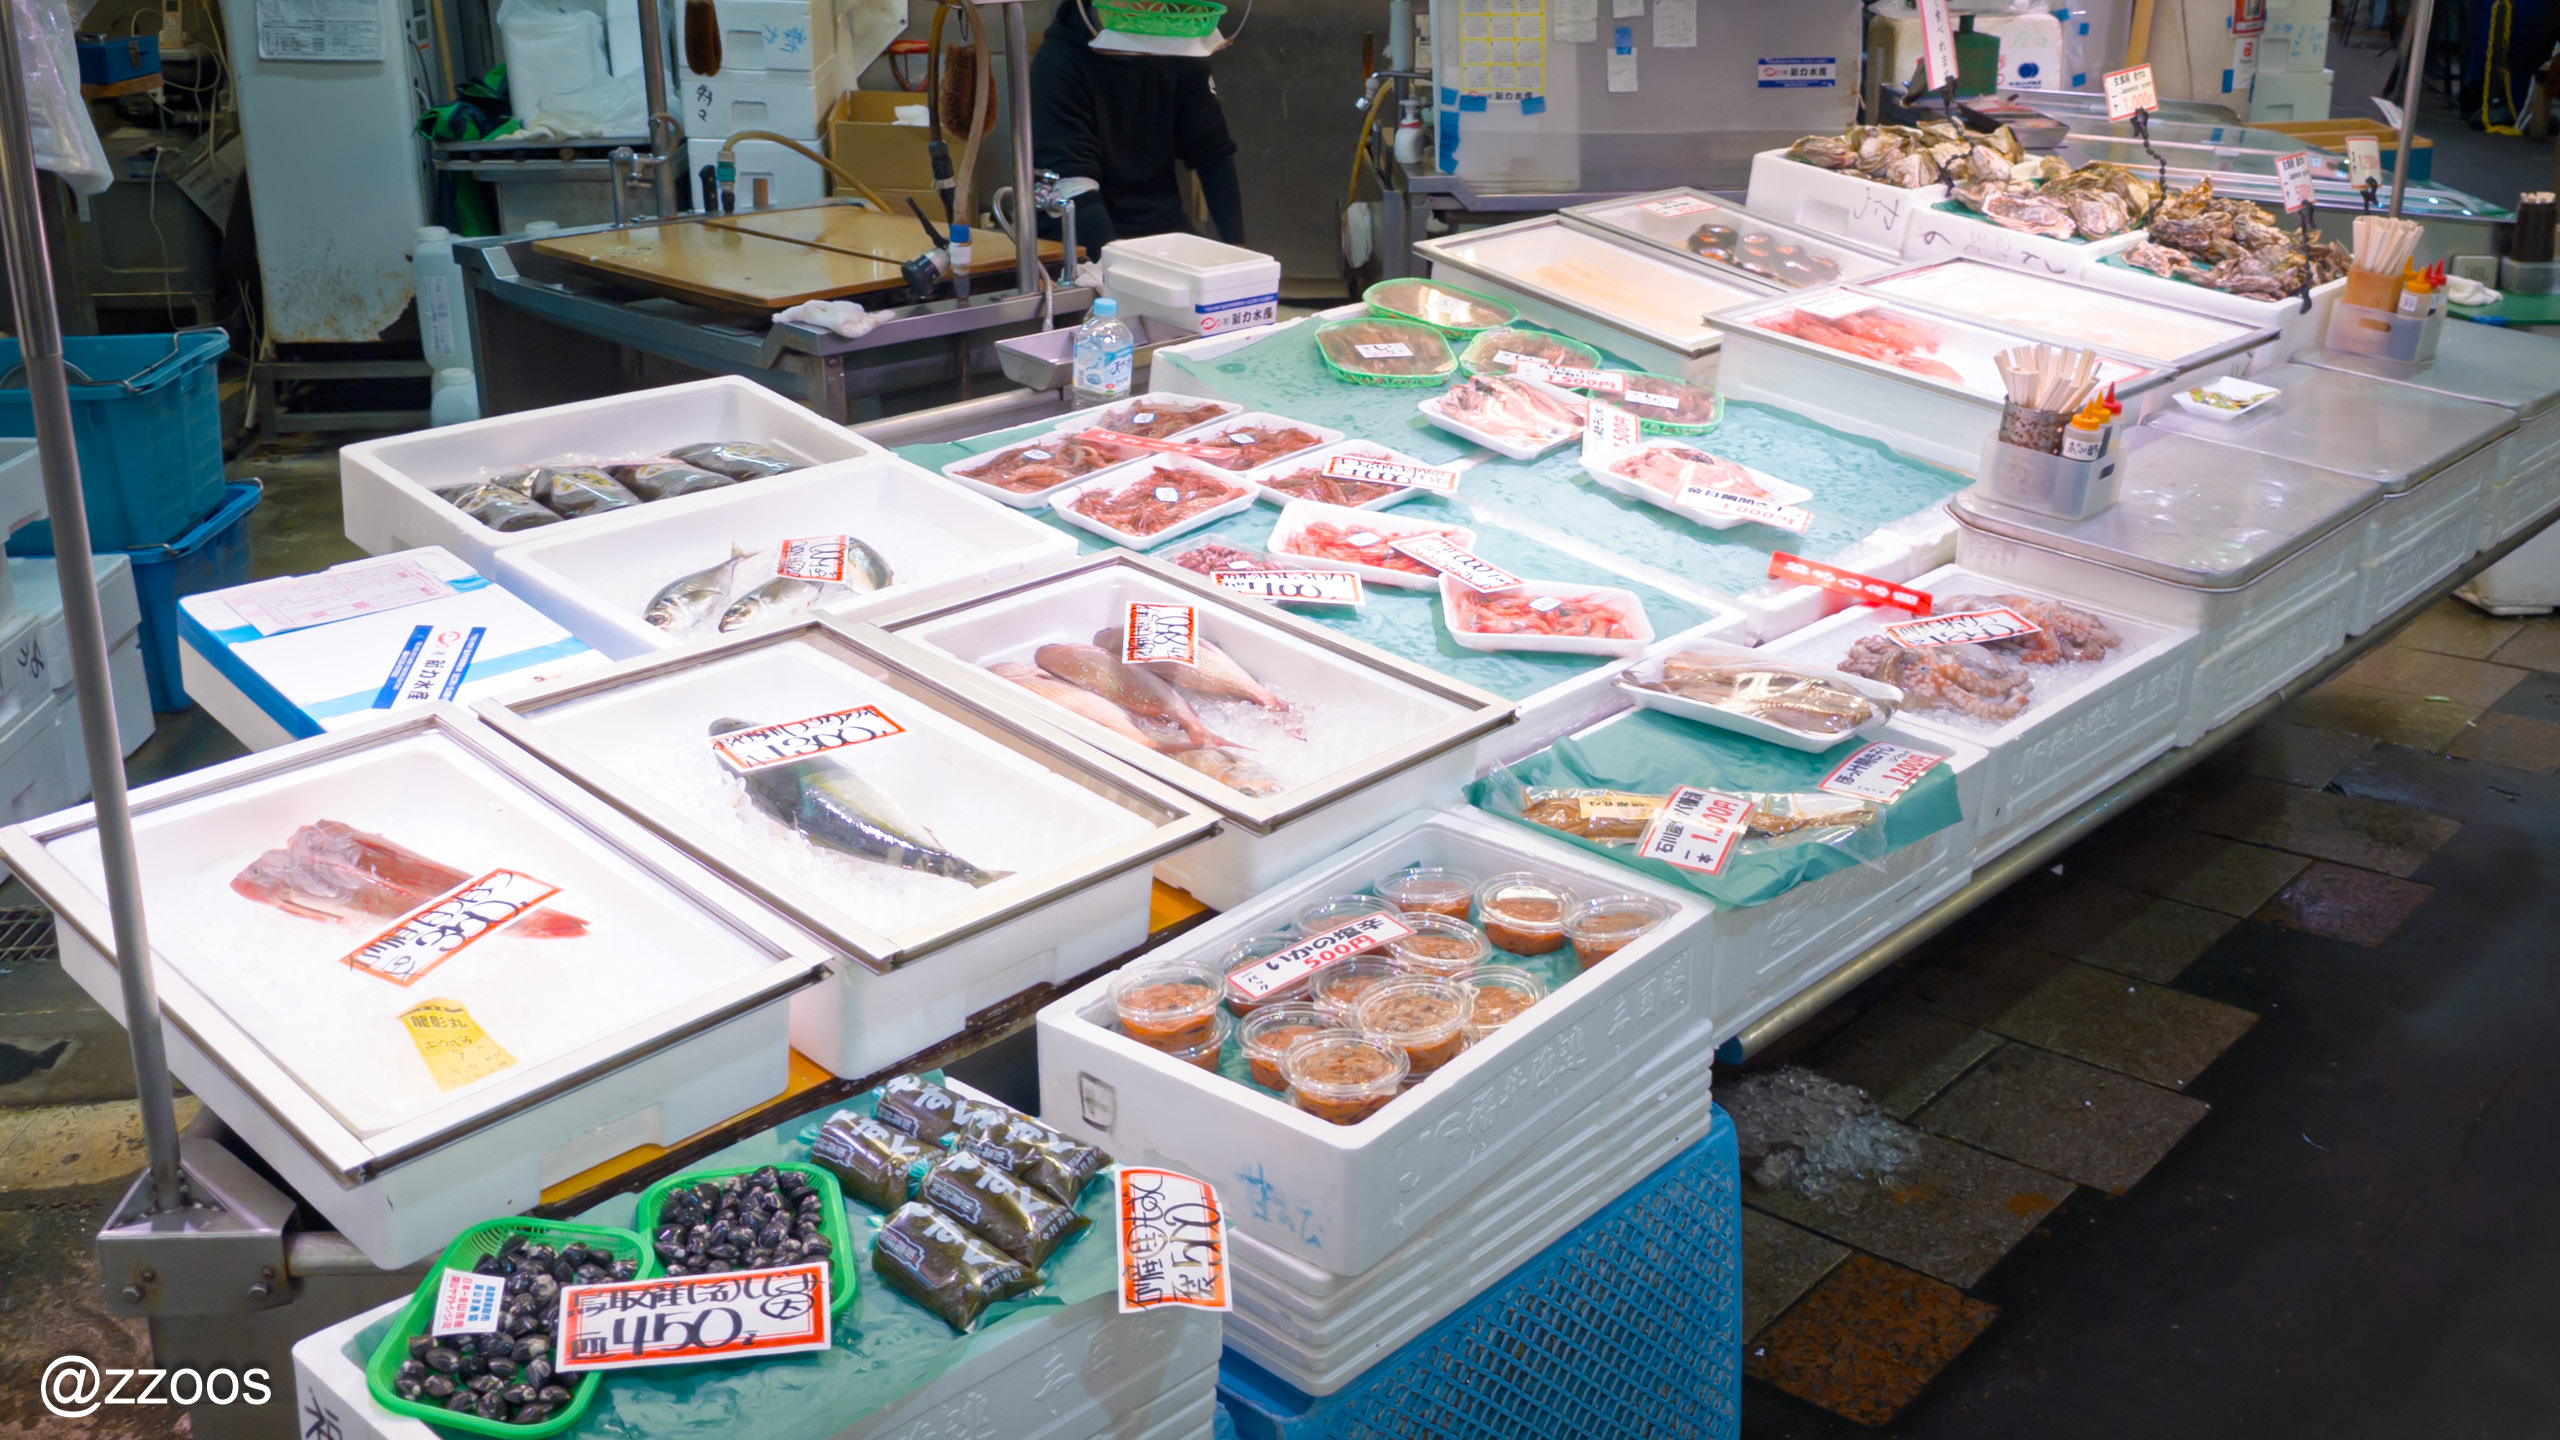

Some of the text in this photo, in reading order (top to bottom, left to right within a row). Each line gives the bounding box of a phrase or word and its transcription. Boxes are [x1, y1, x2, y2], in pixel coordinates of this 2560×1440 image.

[1265, 917, 1386, 971] いかの塩辛
[1303, 934, 1377, 969] 500円
[612, 1307, 744, 1356] 450
